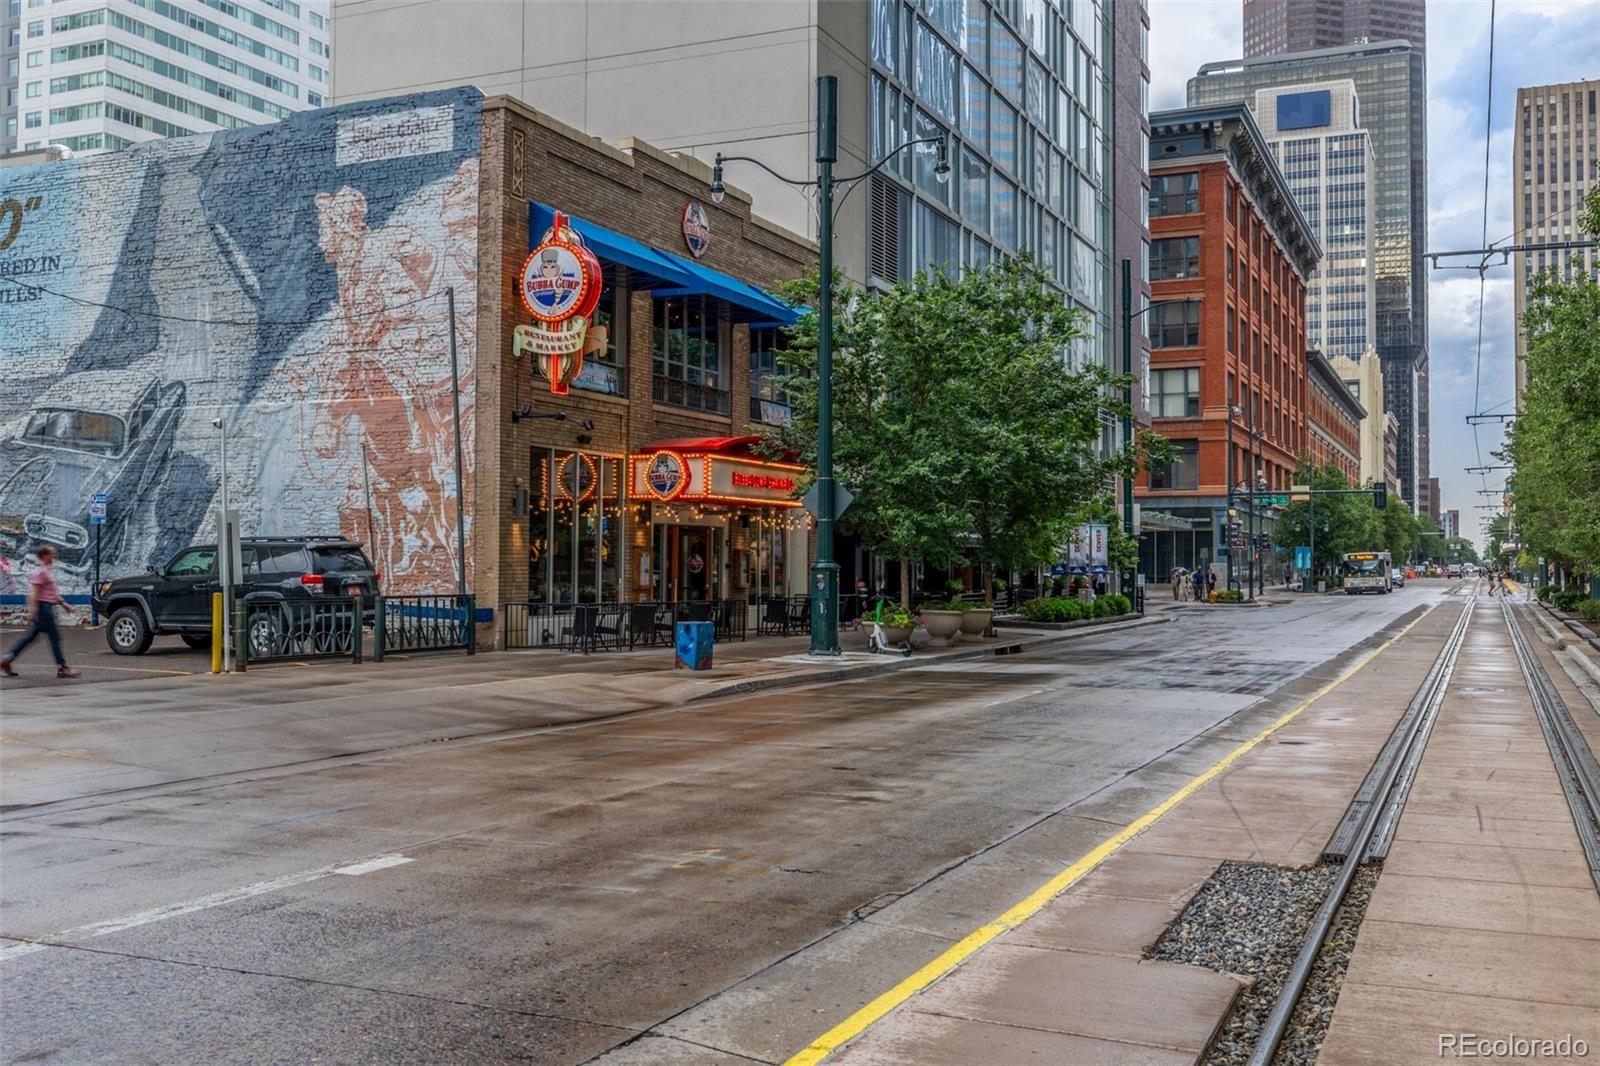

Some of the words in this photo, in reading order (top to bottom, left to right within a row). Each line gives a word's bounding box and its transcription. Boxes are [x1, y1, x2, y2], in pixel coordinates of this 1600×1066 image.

[40, 255, 61, 272] IN
[526, 279, 554, 292] BUBBA
[555, 277, 580, 290] GUMP
[524, 329, 582, 343] RESTAURANT
[526, 340, 533, 348] &
[535, 342, 578, 352] MARKET
